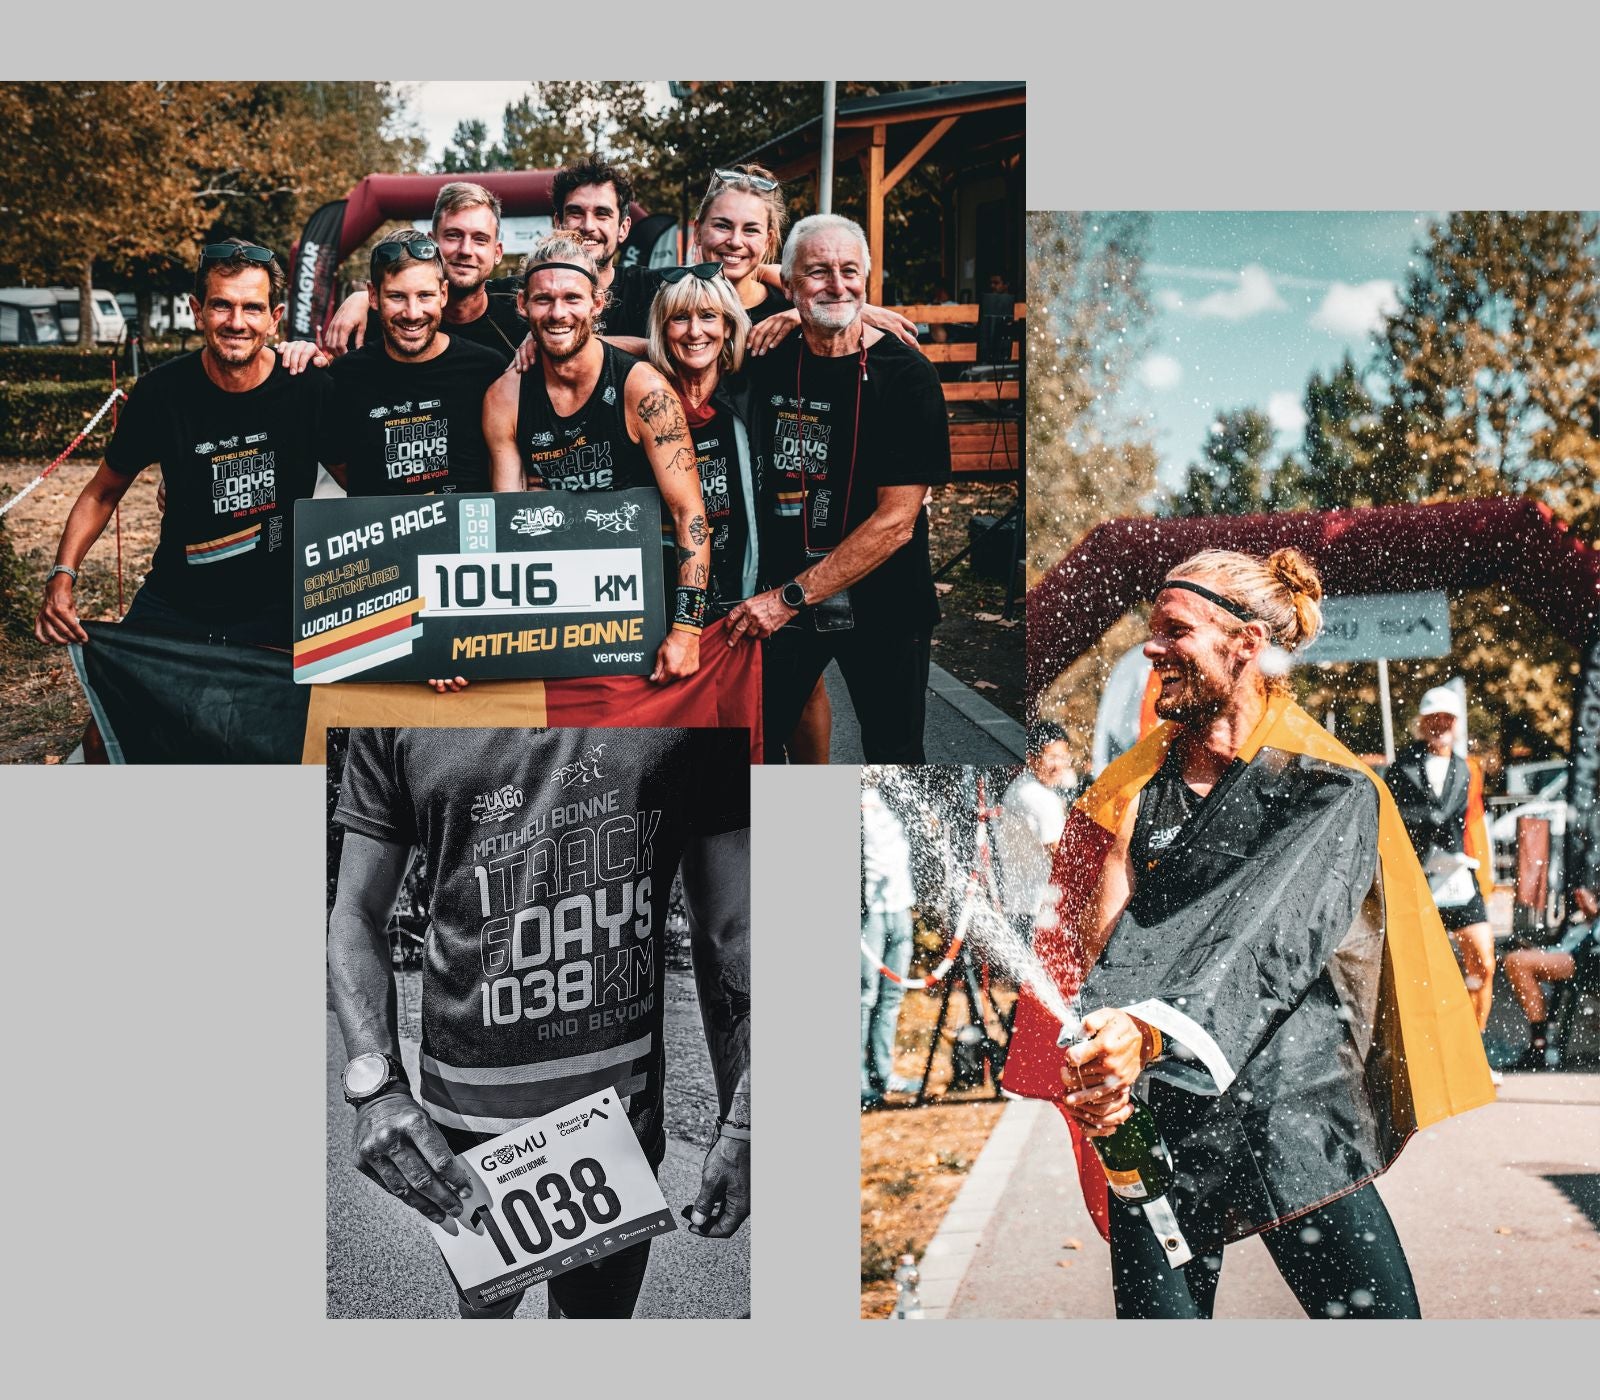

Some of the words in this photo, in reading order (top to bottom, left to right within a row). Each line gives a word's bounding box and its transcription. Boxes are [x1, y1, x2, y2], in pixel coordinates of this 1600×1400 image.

[295, 241, 320, 334] #MAGYAR
[412, 414, 432, 423] BONNE
[407, 475, 421, 483] AND
[233, 509, 248, 518] AND
[465, 503, 490, 518] 5-11
[468, 519, 489, 534] 09
[526, 509, 563, 528] LAGO
[812, 488, 832, 529] TEAM
[304, 542, 321, 568] 6
[327, 521, 386, 560] DAYS
[391, 500, 447, 540] RACE
[304, 558, 370, 592] GOMU-EMU
[304, 565, 400, 610] BALATONFURED
[435, 562, 558, 608] 1046
[594, 574, 638, 602] KM
[302, 608, 352, 639] WORLD
[356, 585, 412, 619] RECORD
[452, 626, 558, 661] MATTHIEU
[563, 617, 644, 649] BONNE
[484, 789, 524, 811] LAGO
[473, 814, 547, 861] MATTHIEU
[552, 789, 620, 829] BONNE
[537, 1018, 579, 1041] AND
[588, 992, 654, 1031] BEYOND
[556, 1116, 580, 1131] Mount
[496, 1165, 528, 1184] MATTHIEU
[527, 1155, 548, 1170] BONNE
[470, 1157, 622, 1266] 1038
